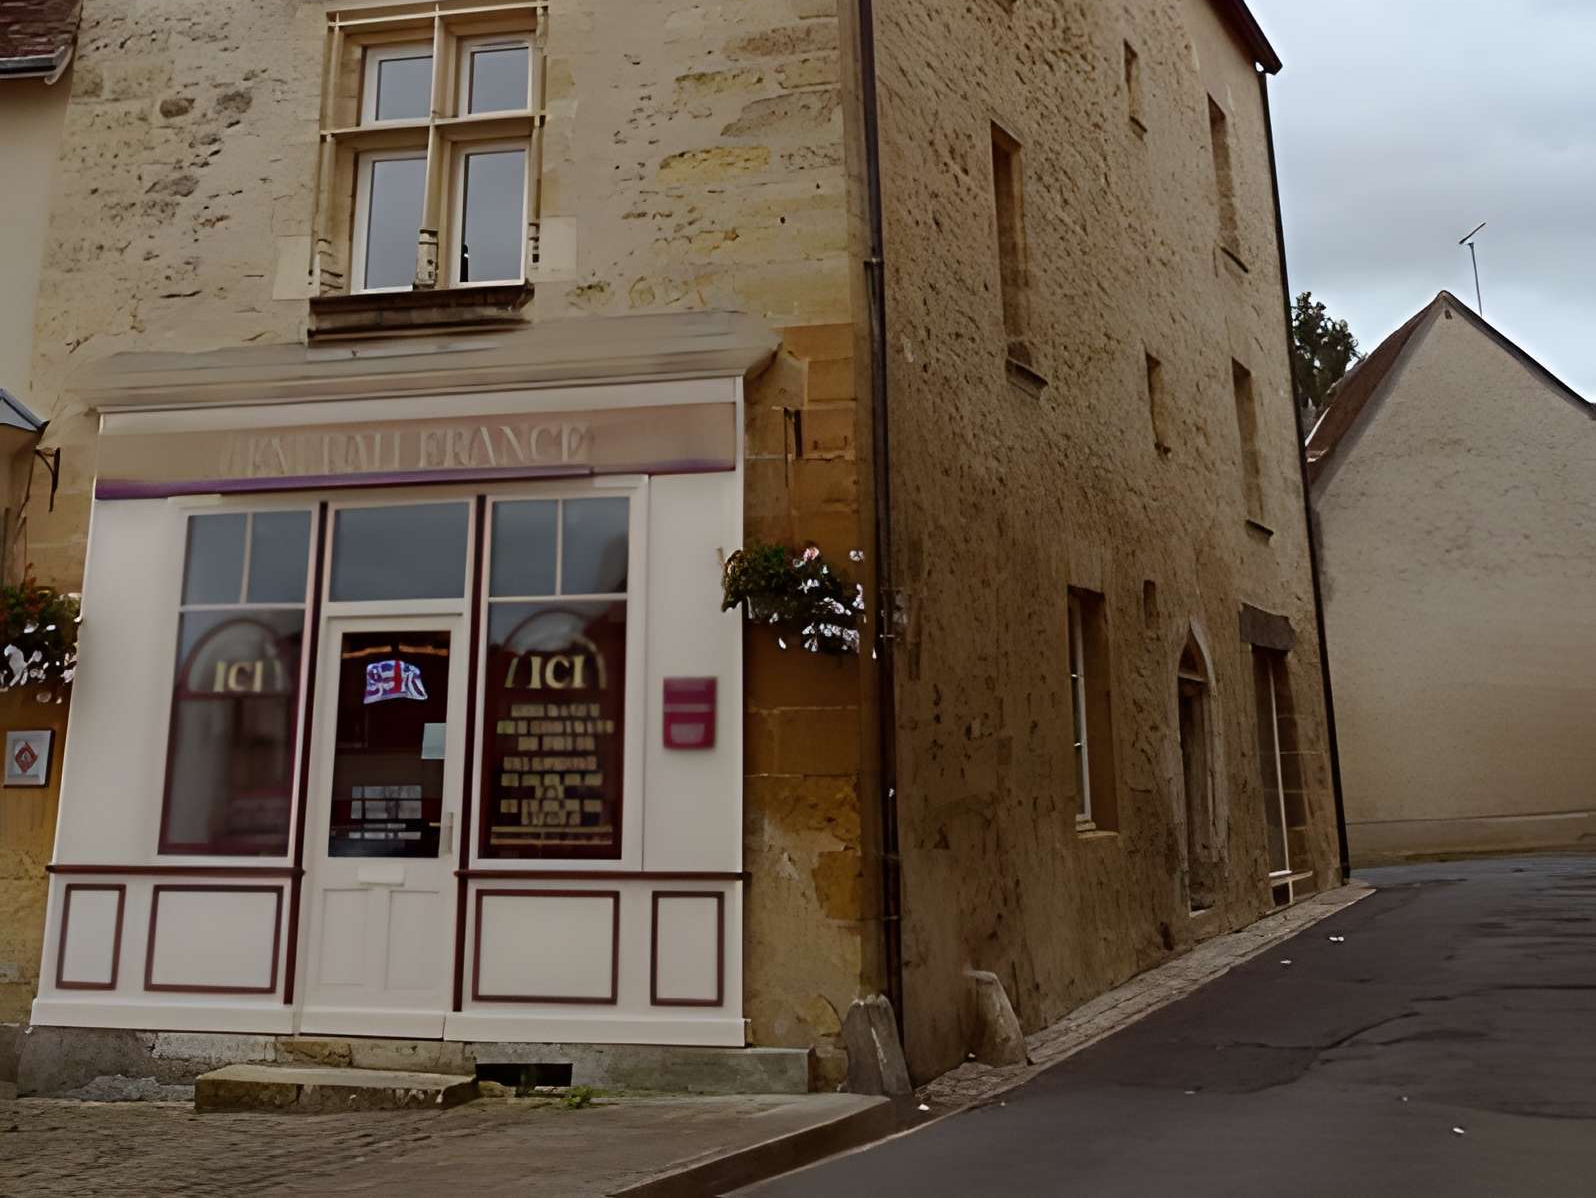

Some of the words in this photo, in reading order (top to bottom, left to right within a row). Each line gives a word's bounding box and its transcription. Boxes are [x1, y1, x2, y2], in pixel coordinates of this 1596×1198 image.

[219, 430, 400, 477] ENRALI
[419, 422, 593, 469] FRANCE
[213, 661, 264, 692] ICI
[528, 655, 587, 689] ICI
